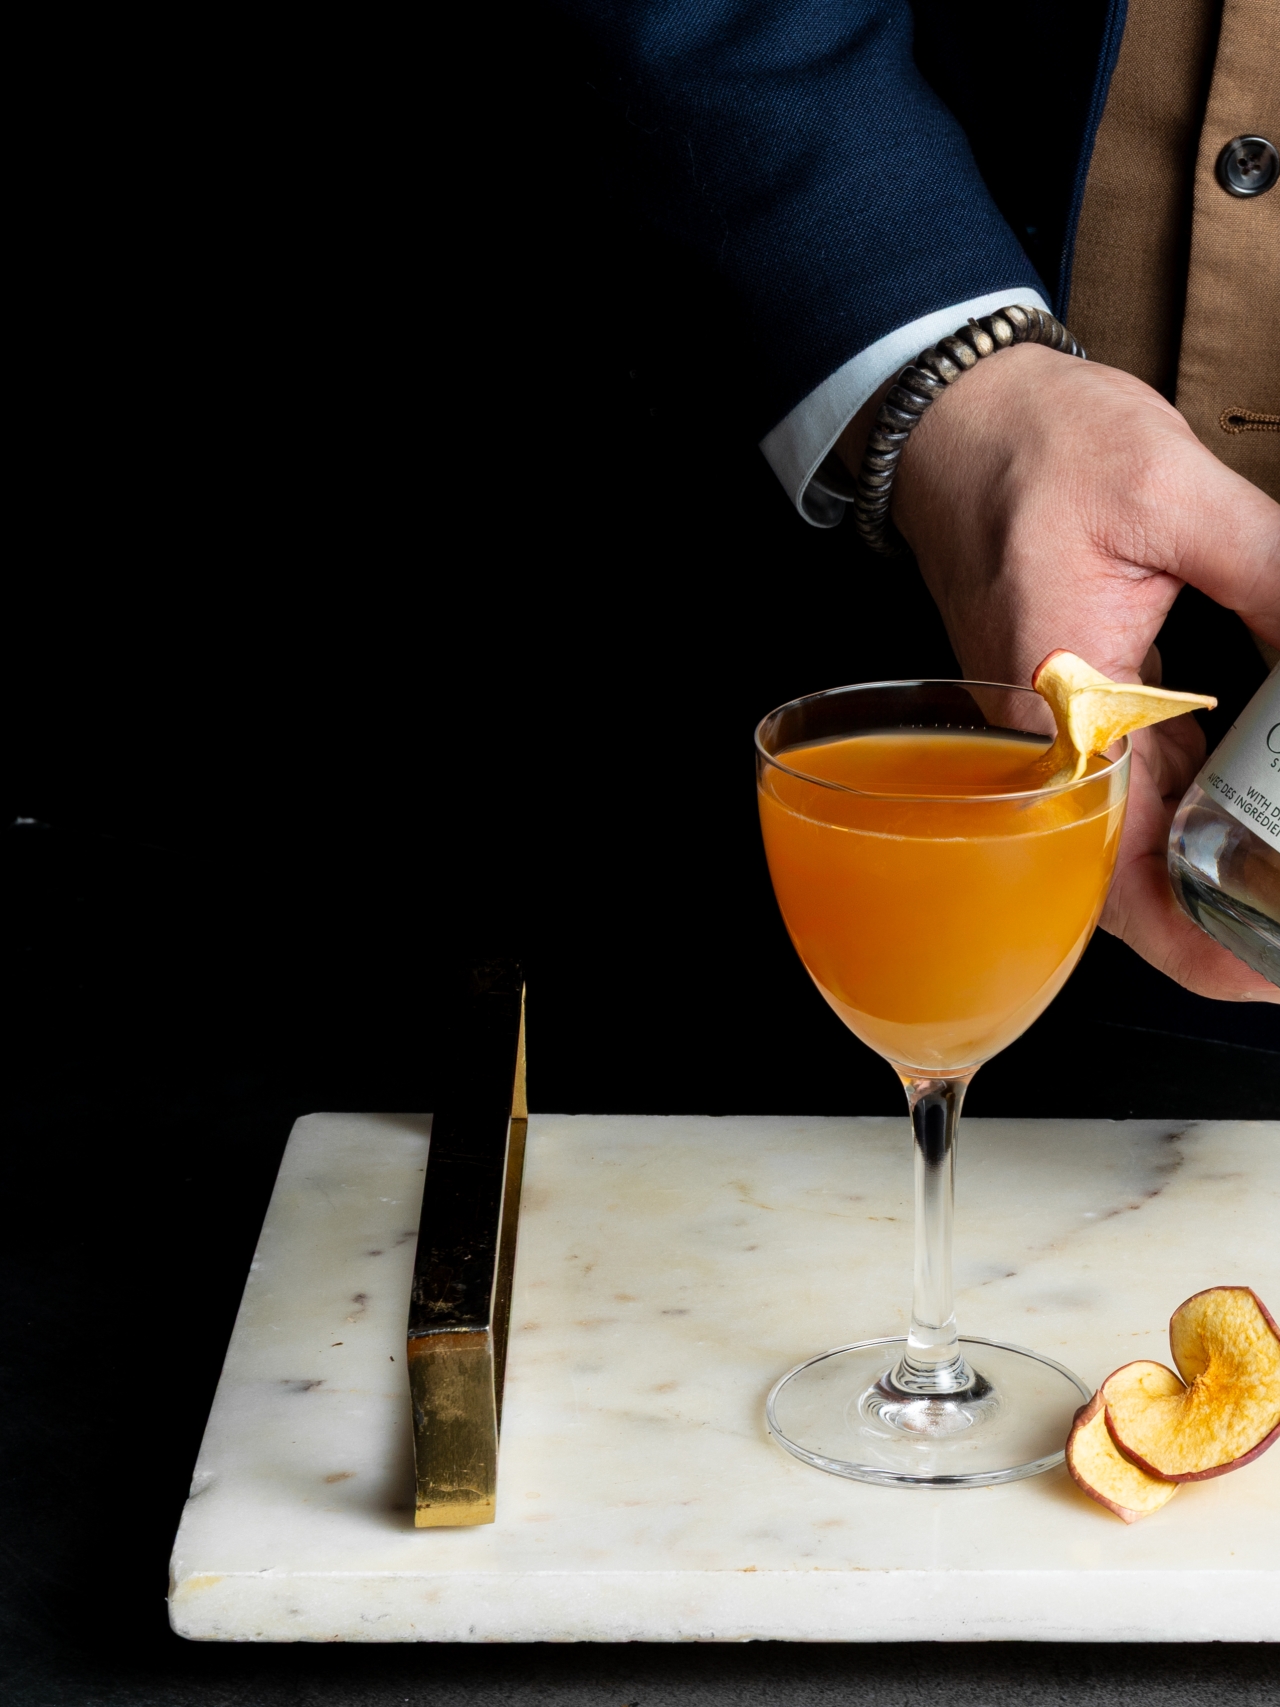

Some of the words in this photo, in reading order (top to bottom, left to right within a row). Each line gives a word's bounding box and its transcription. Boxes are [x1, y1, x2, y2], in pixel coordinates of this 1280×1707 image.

[1206, 772, 1224, 790] AVEC
[1220, 783, 1237, 801] DES
[1246, 786, 1272, 812] WITH
